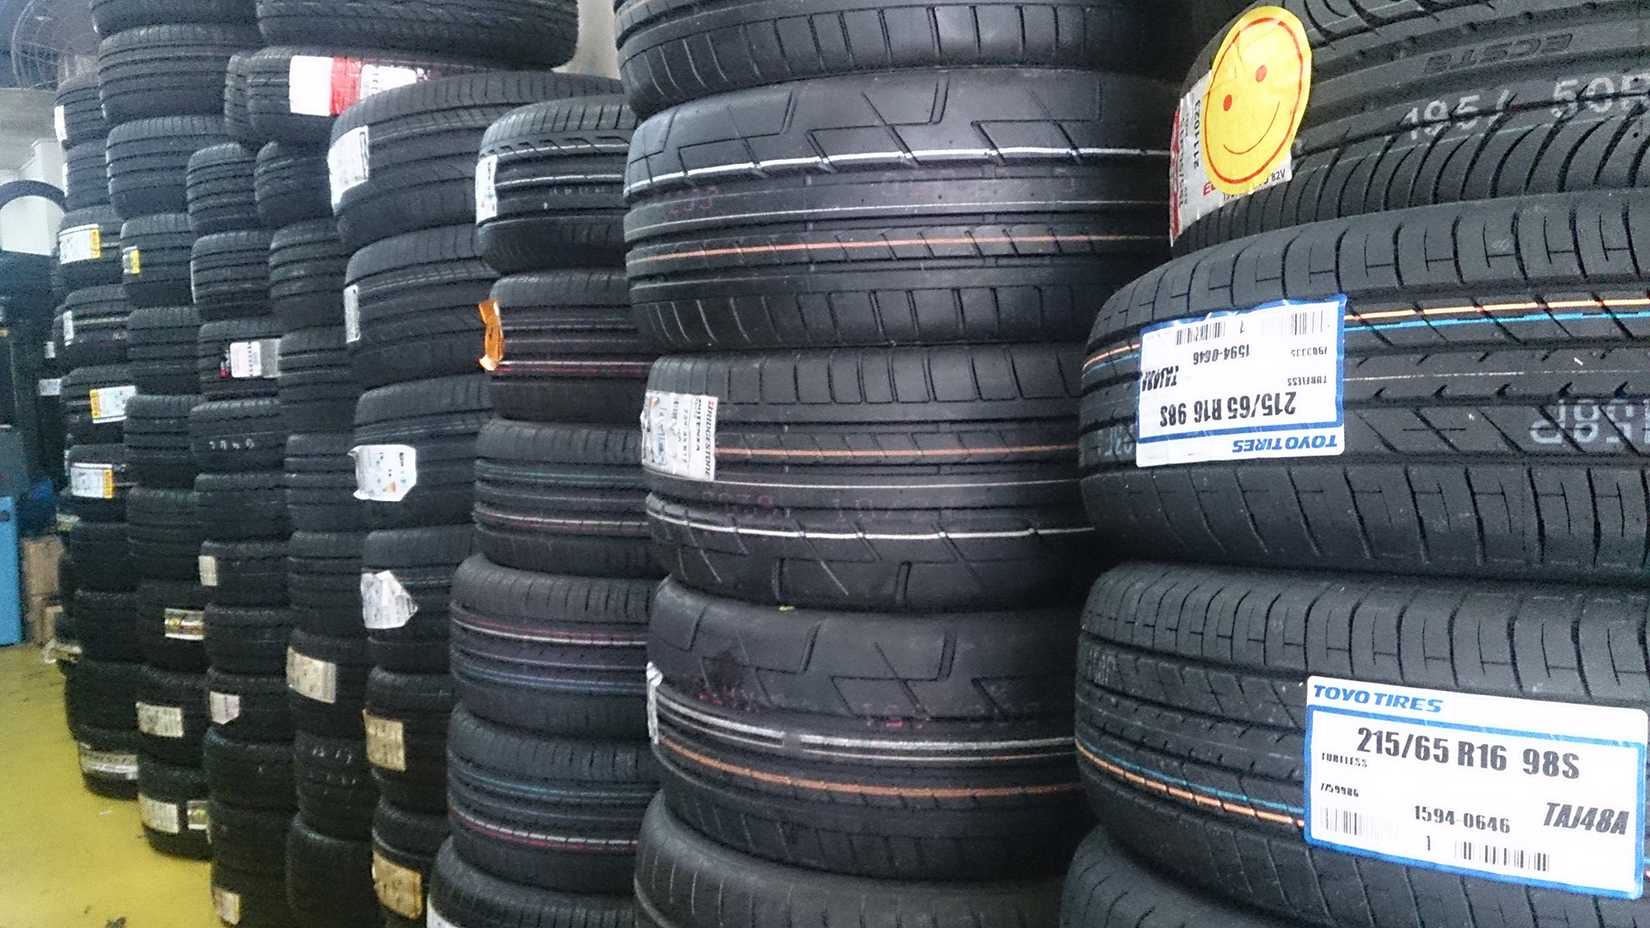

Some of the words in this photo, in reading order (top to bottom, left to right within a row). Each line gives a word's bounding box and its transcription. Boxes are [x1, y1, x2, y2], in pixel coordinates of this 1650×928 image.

[1159, 404, 1187, 428] 98S
[1193, 397, 1223, 423] R16
[1227, 391, 1297, 420] 215/65
[1231, 437, 1282, 453] TIRES
[1284, 434, 1338, 451] TOYO
[1313, 684, 1370, 705] TOYO
[1375, 692, 1444, 714] TIRES
[1356, 726, 1450, 765] 215/65
[1457, 740, 1508, 771] R16
[1522, 751, 1580, 780] 98S
[1414, 804, 1511, 834] 1594-0646
[1543, 801, 1631, 836] TAJ48A
